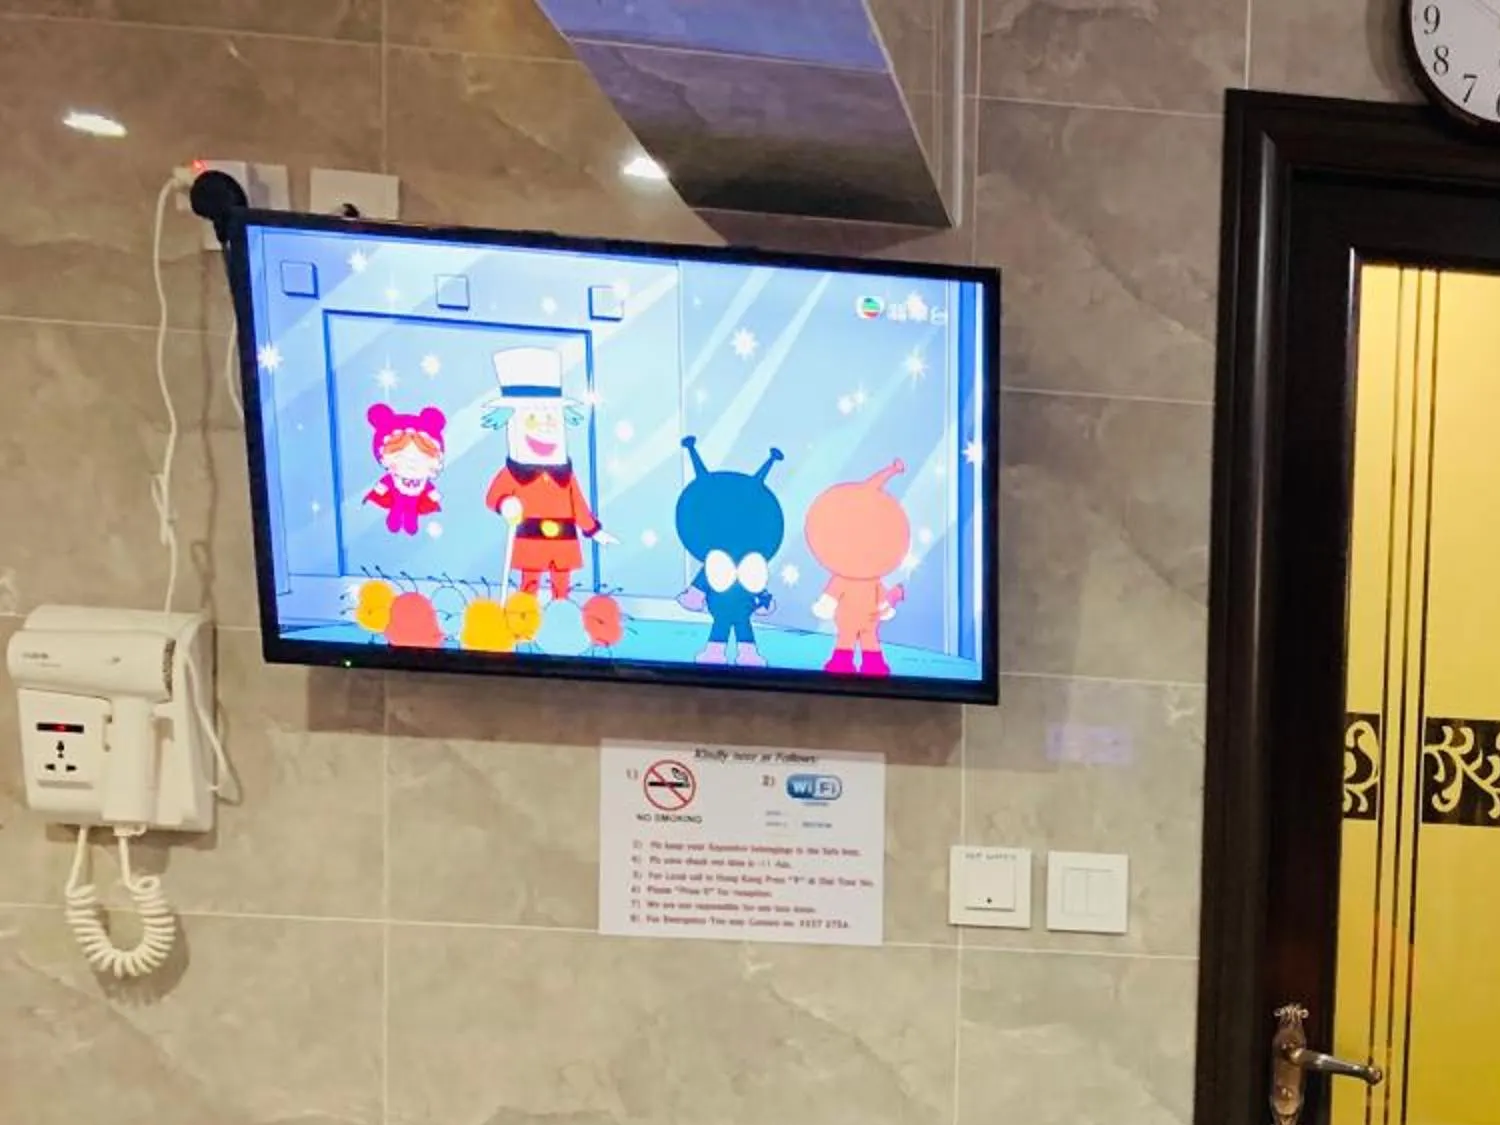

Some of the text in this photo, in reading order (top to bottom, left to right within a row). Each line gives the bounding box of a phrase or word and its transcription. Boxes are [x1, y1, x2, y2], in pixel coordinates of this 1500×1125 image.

[1424, 5, 1440, 35] 9
[1433, 45, 1449, 75] 8
[1463, 74, 1478, 103] 7
